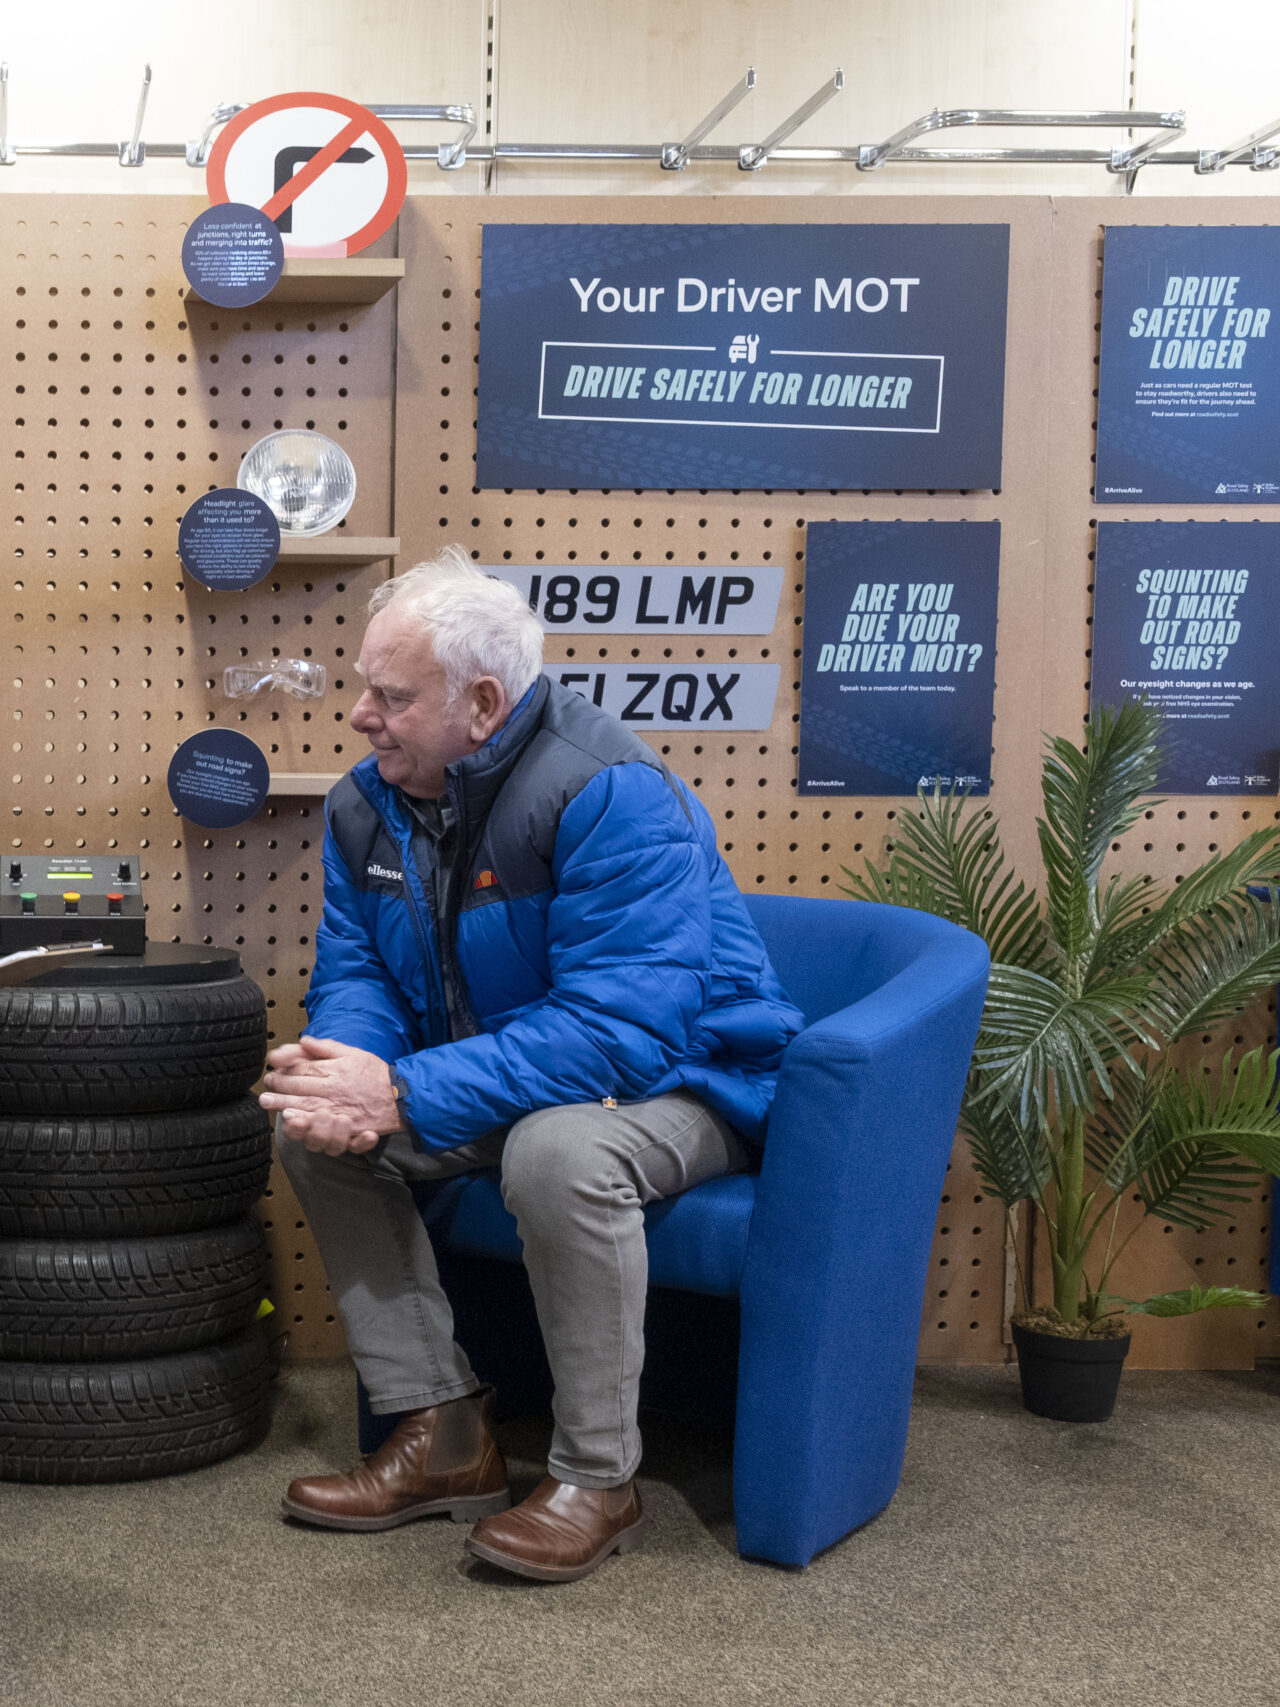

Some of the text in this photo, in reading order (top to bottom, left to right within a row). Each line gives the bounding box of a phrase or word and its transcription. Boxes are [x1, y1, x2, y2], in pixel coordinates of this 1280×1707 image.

[197, 231, 230, 240] junctions,
[232, 231, 247, 239] right
[205, 239, 233, 247] merging
[569, 277, 920, 313] Your Driver MOT
[1163, 276, 1240, 306] DRIVE
[1128, 307, 1270, 338] SAFELY FOR
[1149, 339, 1247, 369] LONGER
[563, 365, 913, 409] DRIVE SAFELY FOR LONGER
[1158, 390, 1196, 398] roadworthy,
[204, 500, 236, 508] Headlight
[1136, 569, 1249, 595] SQUINTING
[635, 576, 754, 625] LMP
[849, 583, 955, 612] ARE YOU
[1146, 595, 1239, 620] TO MAKE
[841, 614, 960, 642] DUE YOUR
[1139, 620, 1242, 645] OUT ROAD
[816, 643, 983, 673] DRIVER MOT?
[1150, 646, 1229, 671] SIGNS?
[839, 684, 859, 693] Speak
[900, 684, 907, 692] of
[937, 685, 956, 693] today.
[1120, 679, 1137, 688] Our
[1138, 679, 1174, 689] eyesight
[1175, 679, 1211, 689] changes
[1237, 681, 1255, 689] age.
[620, 673, 740, 722] ZQX
[193, 751, 225, 764] Squinting
[235, 760, 252, 769] make
[208, 763, 223, 771] road
[225, 767, 245, 776] signs?
[367, 864, 404, 881] ellesse
